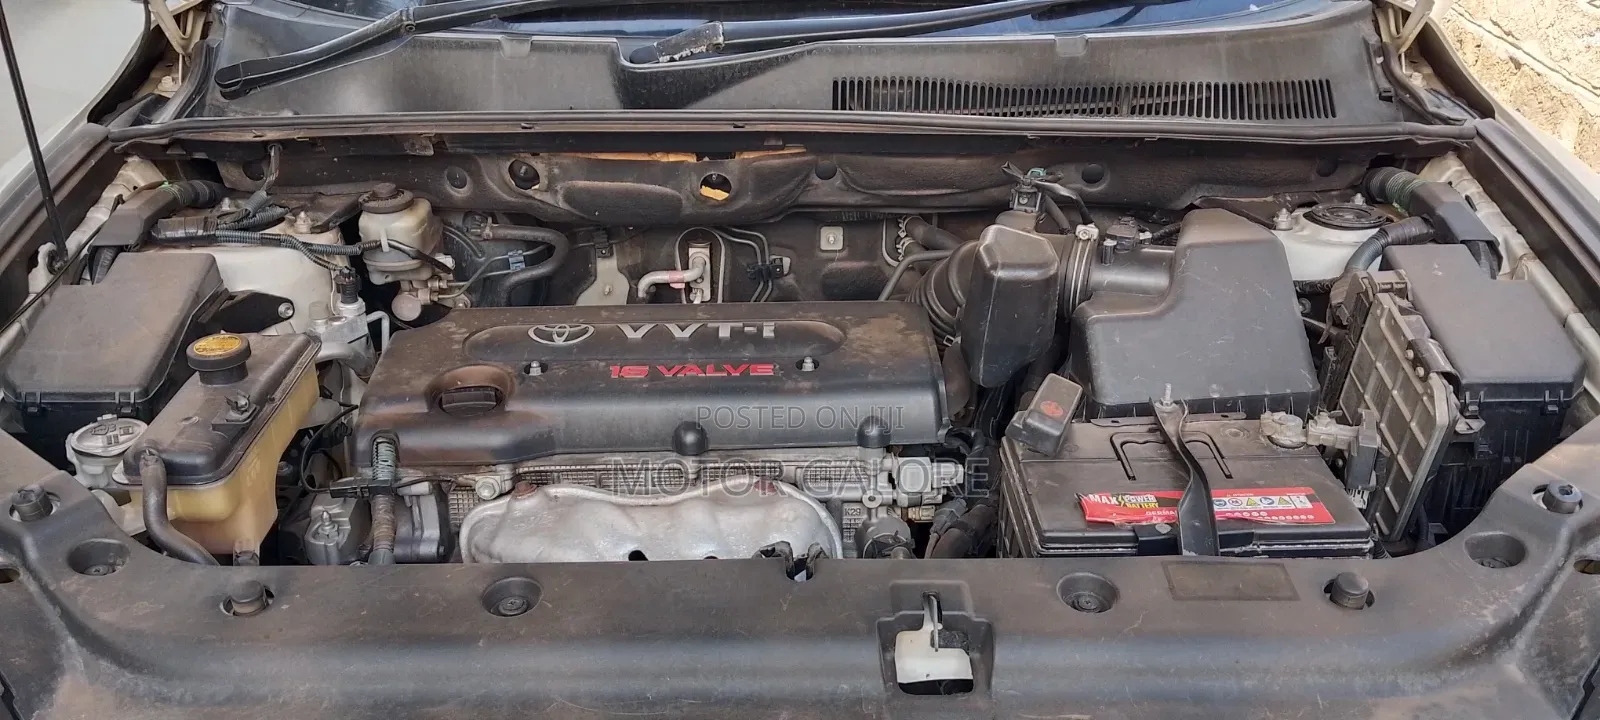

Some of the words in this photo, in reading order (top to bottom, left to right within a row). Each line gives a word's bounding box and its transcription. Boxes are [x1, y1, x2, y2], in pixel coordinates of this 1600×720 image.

[609, 365, 650, 379] 16
[655, 363, 775, 377] VALVE
[1087, 493, 1120, 505] MAX
[1124, 494, 1157, 503] POWER
[844, 507, 862, 517] K29
